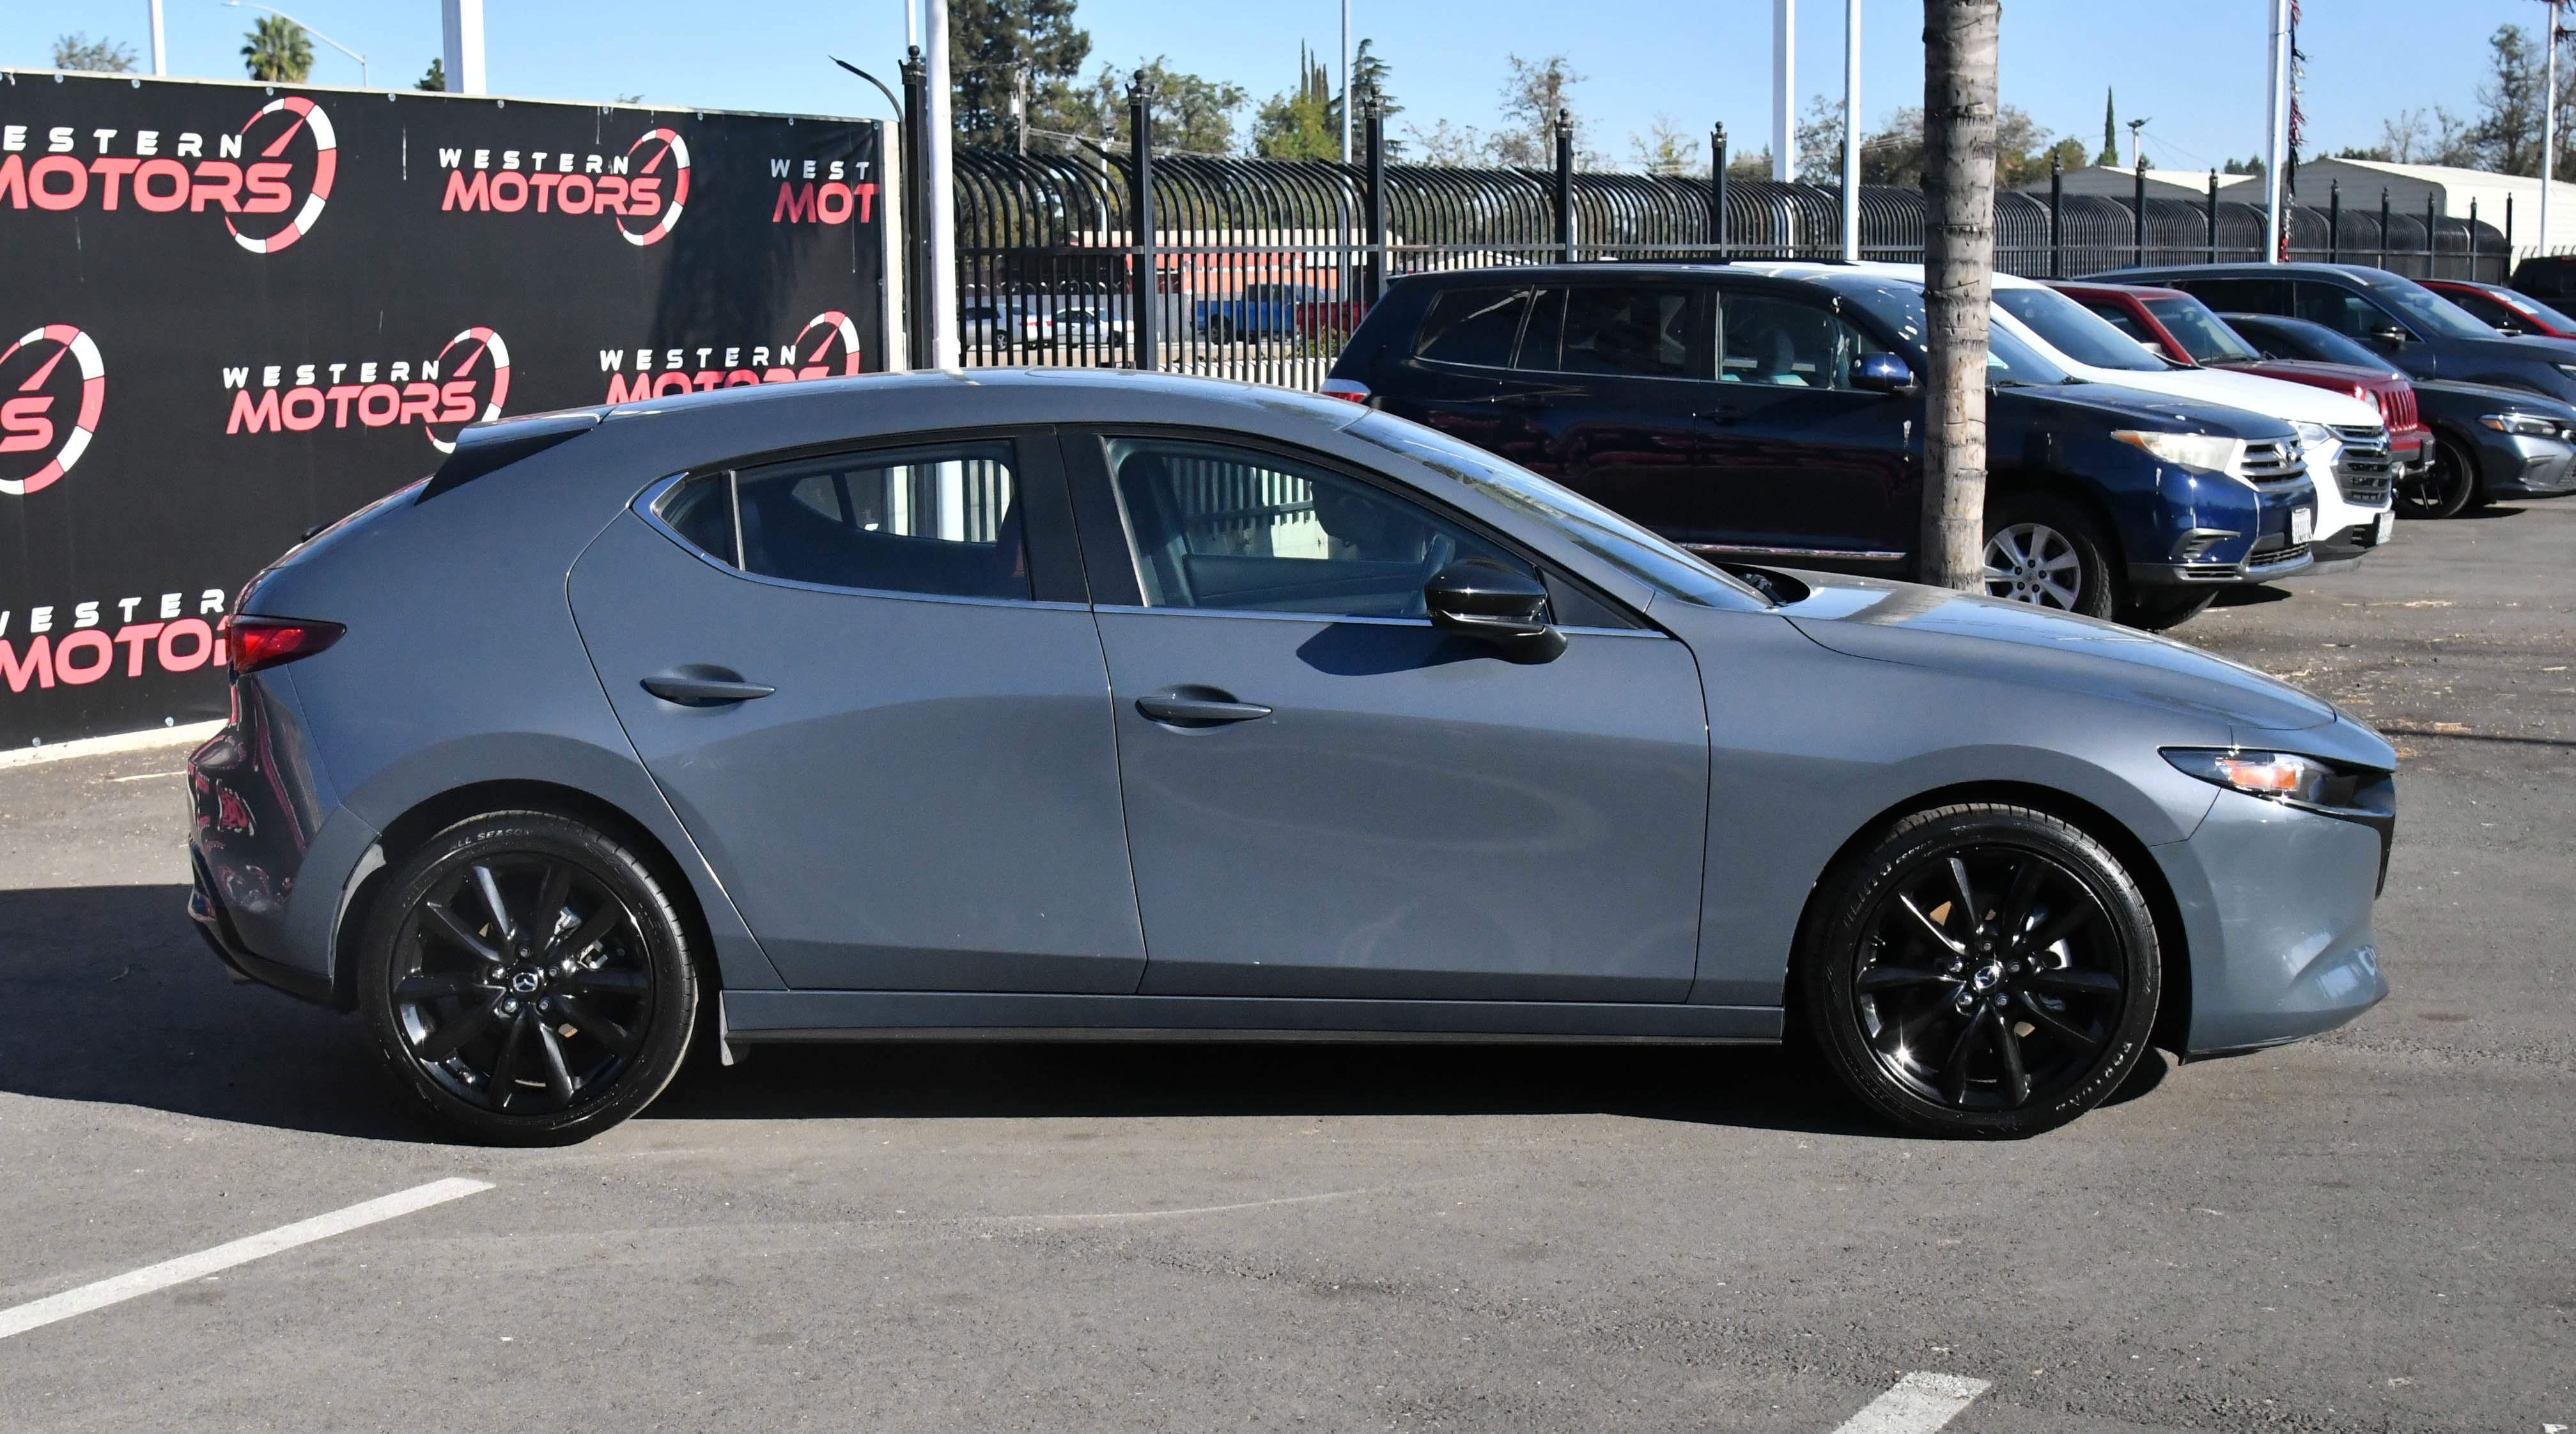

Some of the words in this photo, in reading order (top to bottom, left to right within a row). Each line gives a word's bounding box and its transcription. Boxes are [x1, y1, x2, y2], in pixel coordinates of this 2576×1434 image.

[439, 148, 629, 175] WESTERN
[770, 158, 870, 180] WEST
[441, 169, 661, 216] MOTORS
[772, 182, 880, 224] MOT
[600, 345, 797, 371] WESTERN
[223, 360, 439, 389] WESTERN
[226, 380, 477, 435] MOTORS
